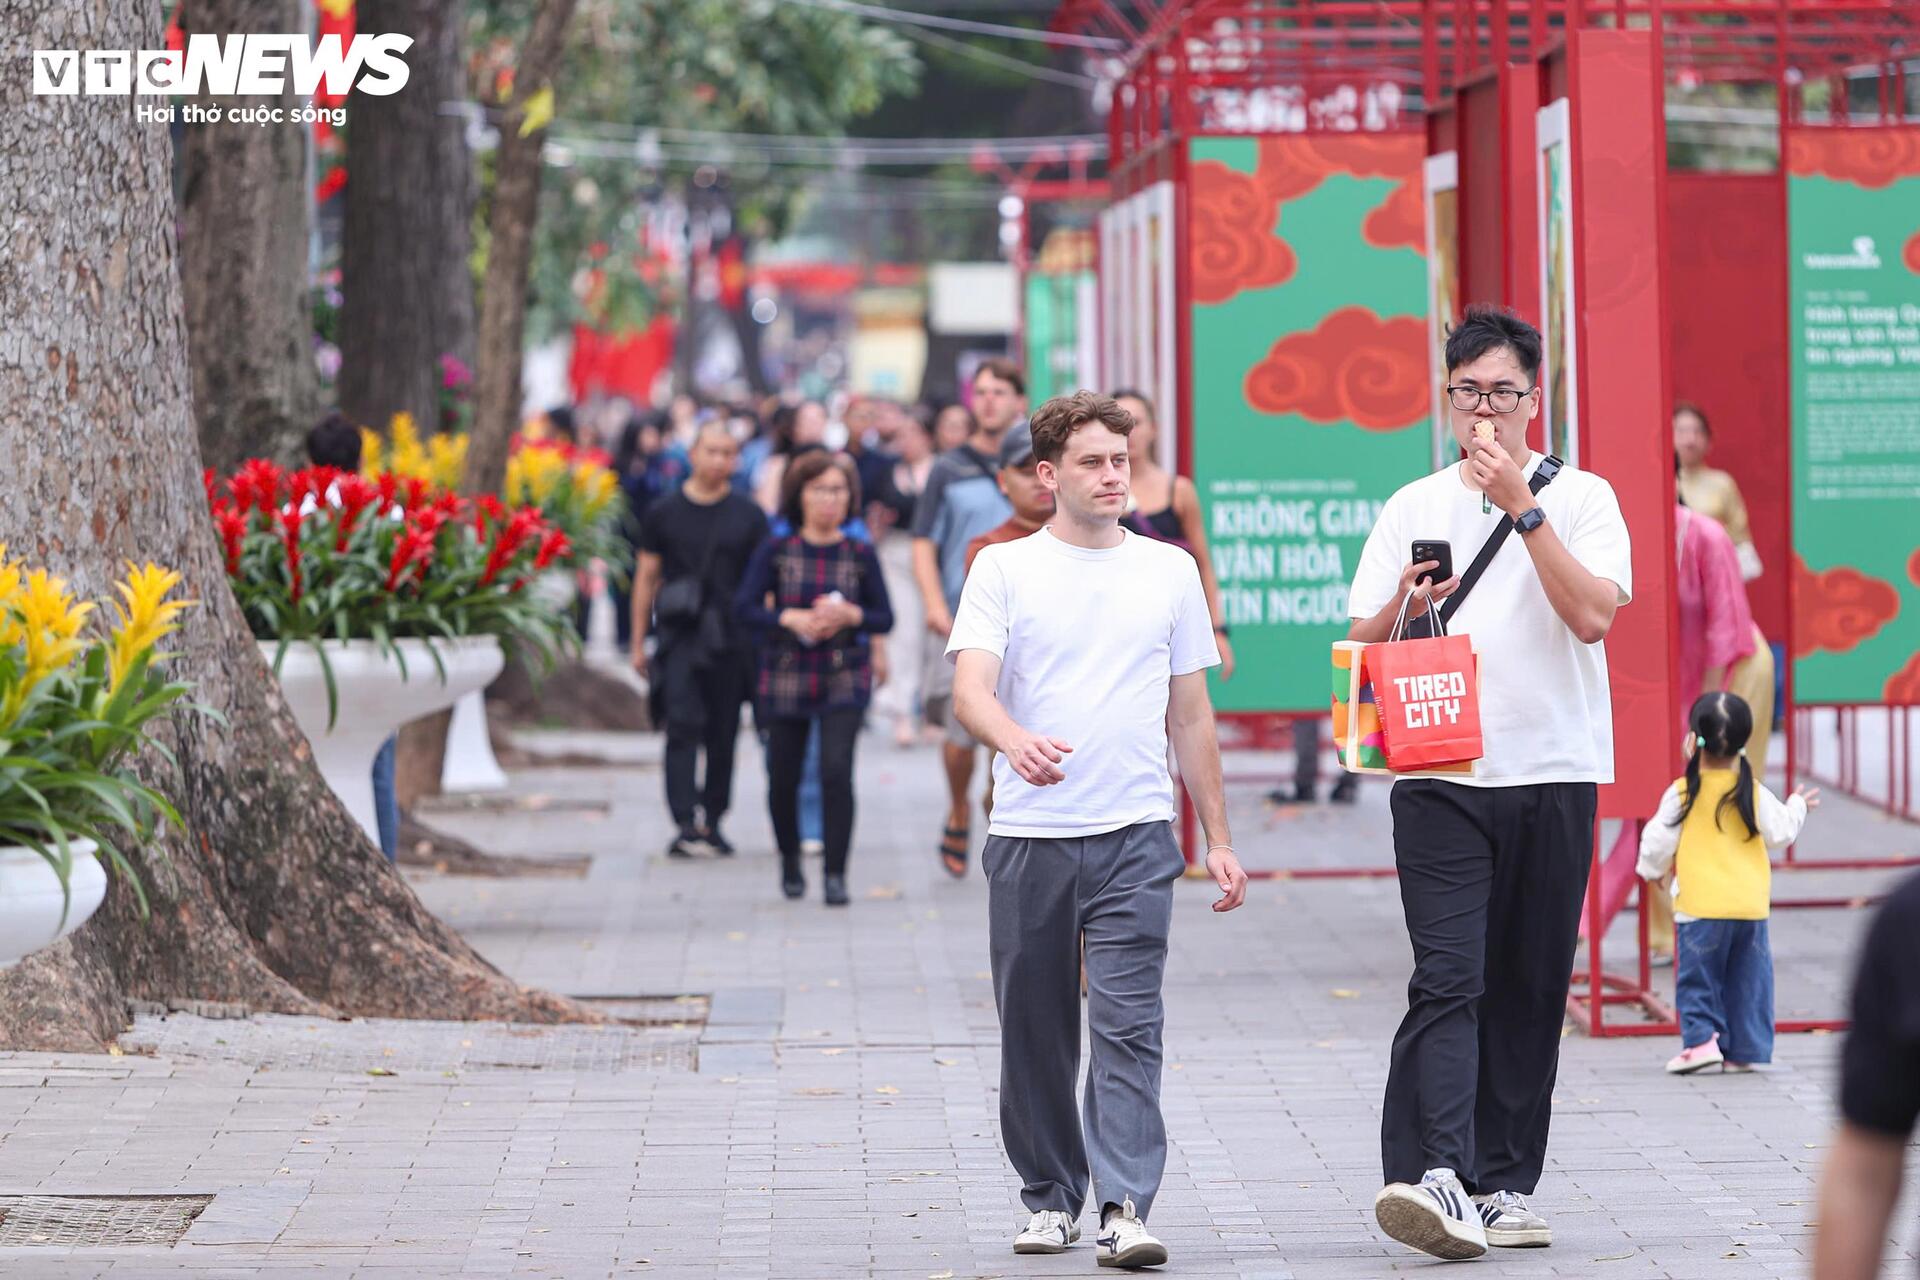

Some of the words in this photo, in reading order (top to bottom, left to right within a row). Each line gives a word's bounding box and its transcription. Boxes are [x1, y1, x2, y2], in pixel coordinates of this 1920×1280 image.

[1212, 494, 1316, 537] KHÔNG
[1212, 540, 1274, 580] VĂN
[1279, 539, 1343, 579] HÓA
[1393, 671, 1467, 702] TIRED
[1404, 698, 1461, 729] CITY
